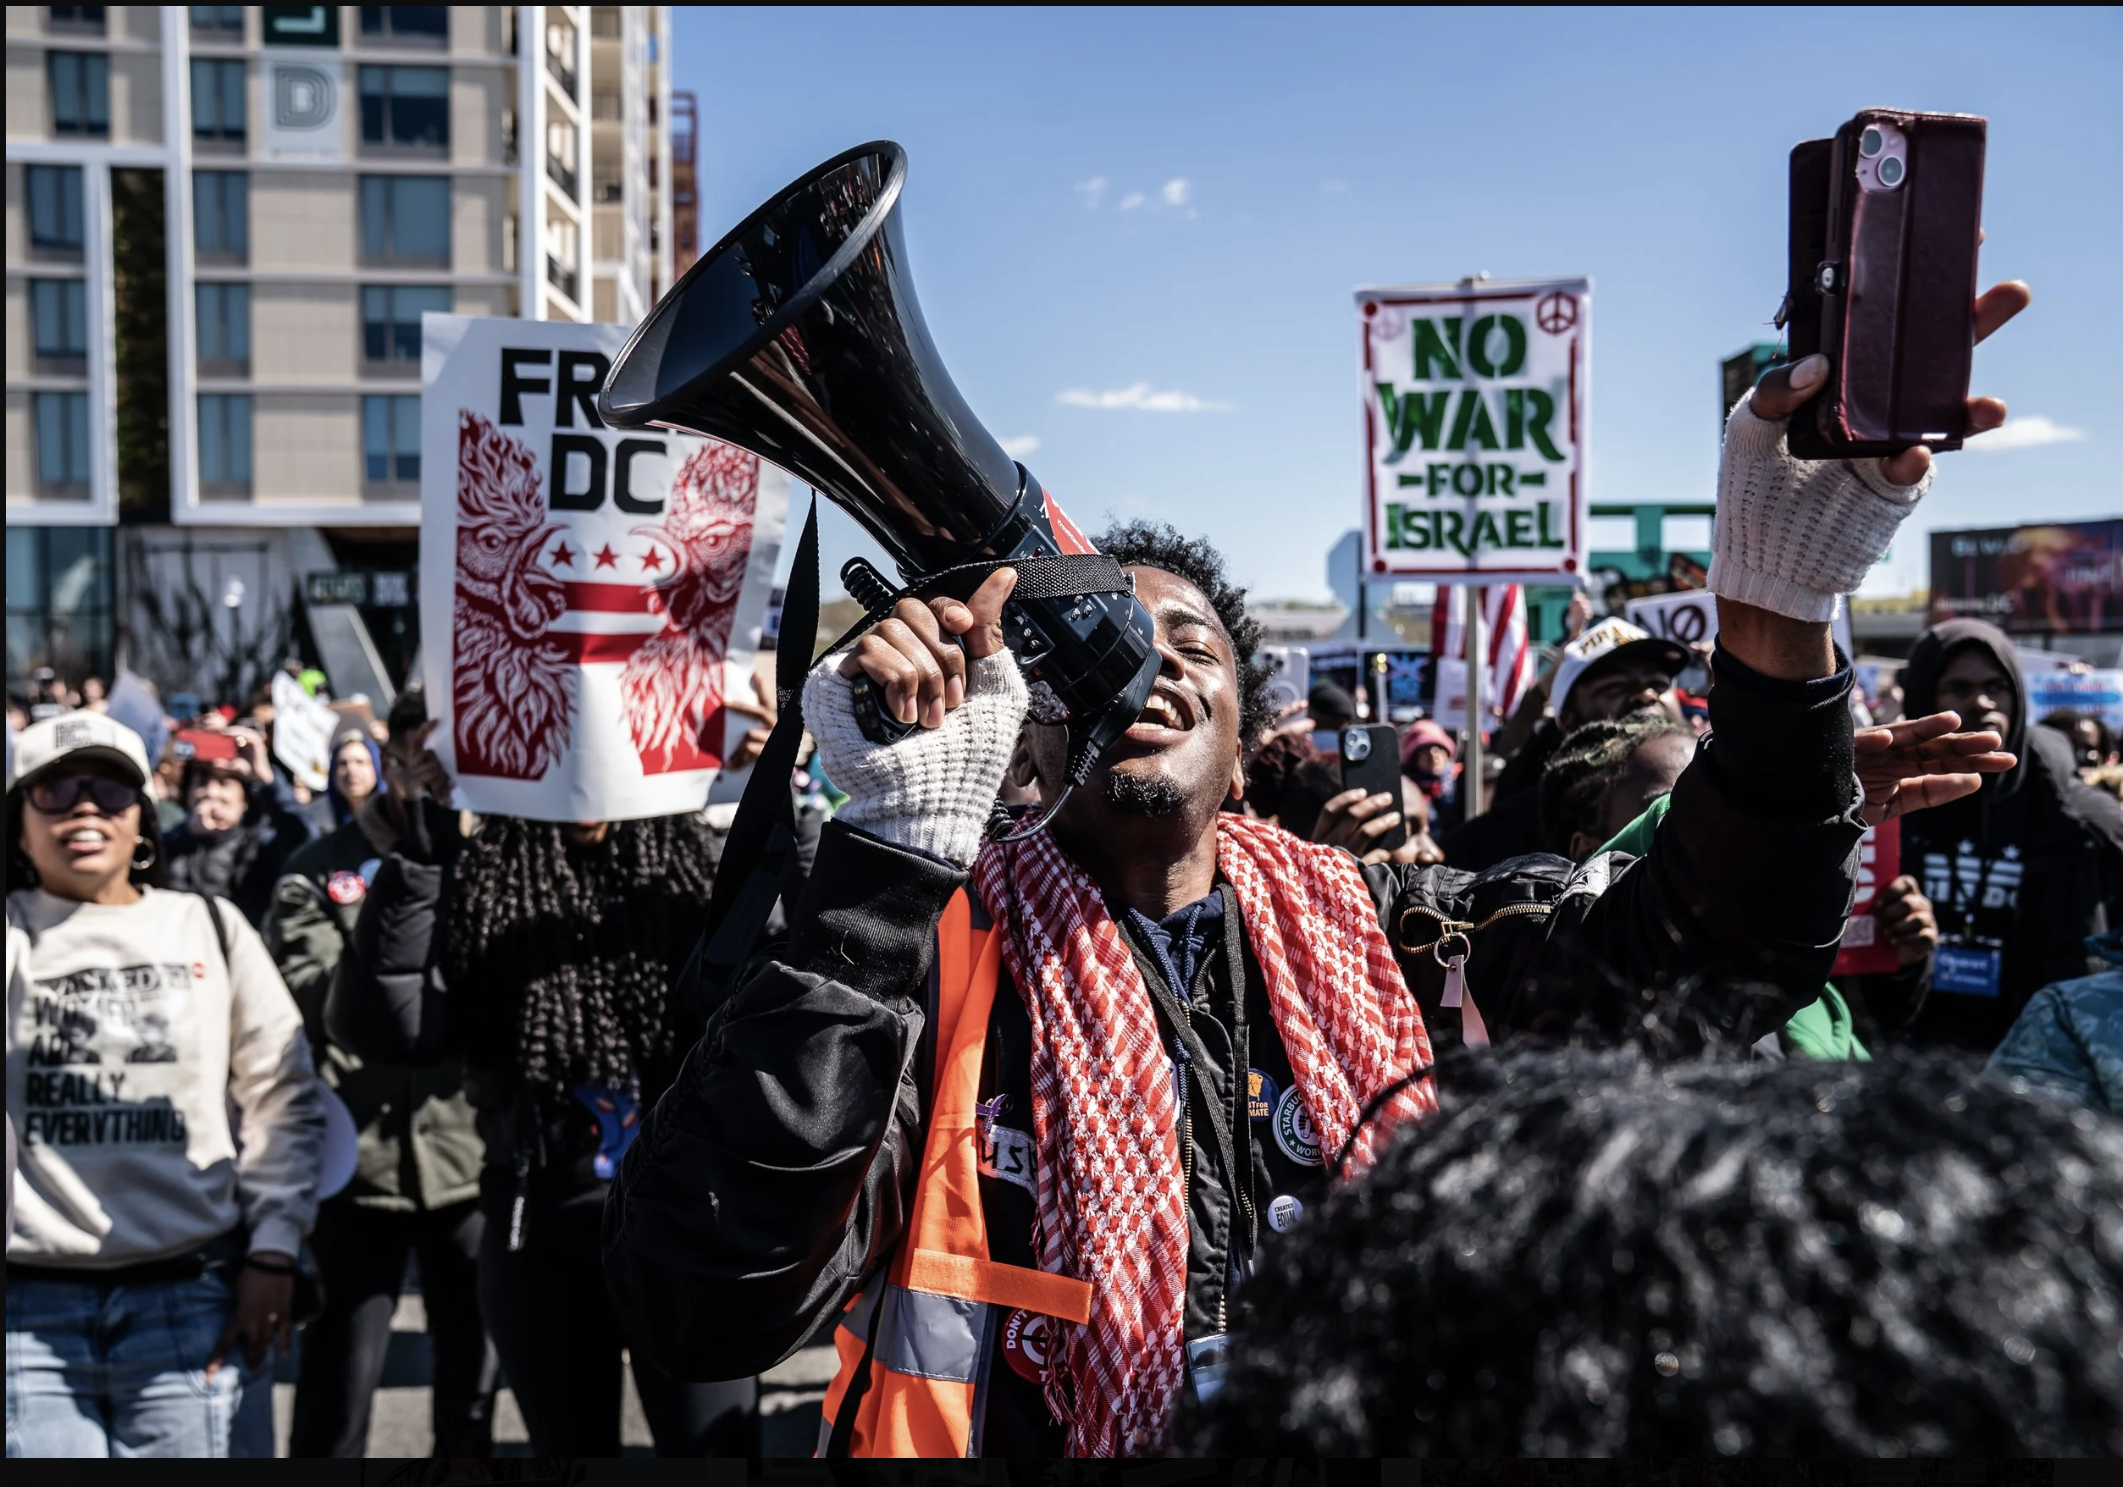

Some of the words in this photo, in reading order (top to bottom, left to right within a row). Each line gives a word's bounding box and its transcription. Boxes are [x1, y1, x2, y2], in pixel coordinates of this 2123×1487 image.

[1411, 313, 1527, 380] NO
[1376, 382, 1566, 463] WAR
[549, 433, 668, 514] DC
[1385, 501, 1565, 558] ISRAEL
[27, 1070, 126, 1107] REALLY
[24, 1108, 187, 1147] EVERYTHING
